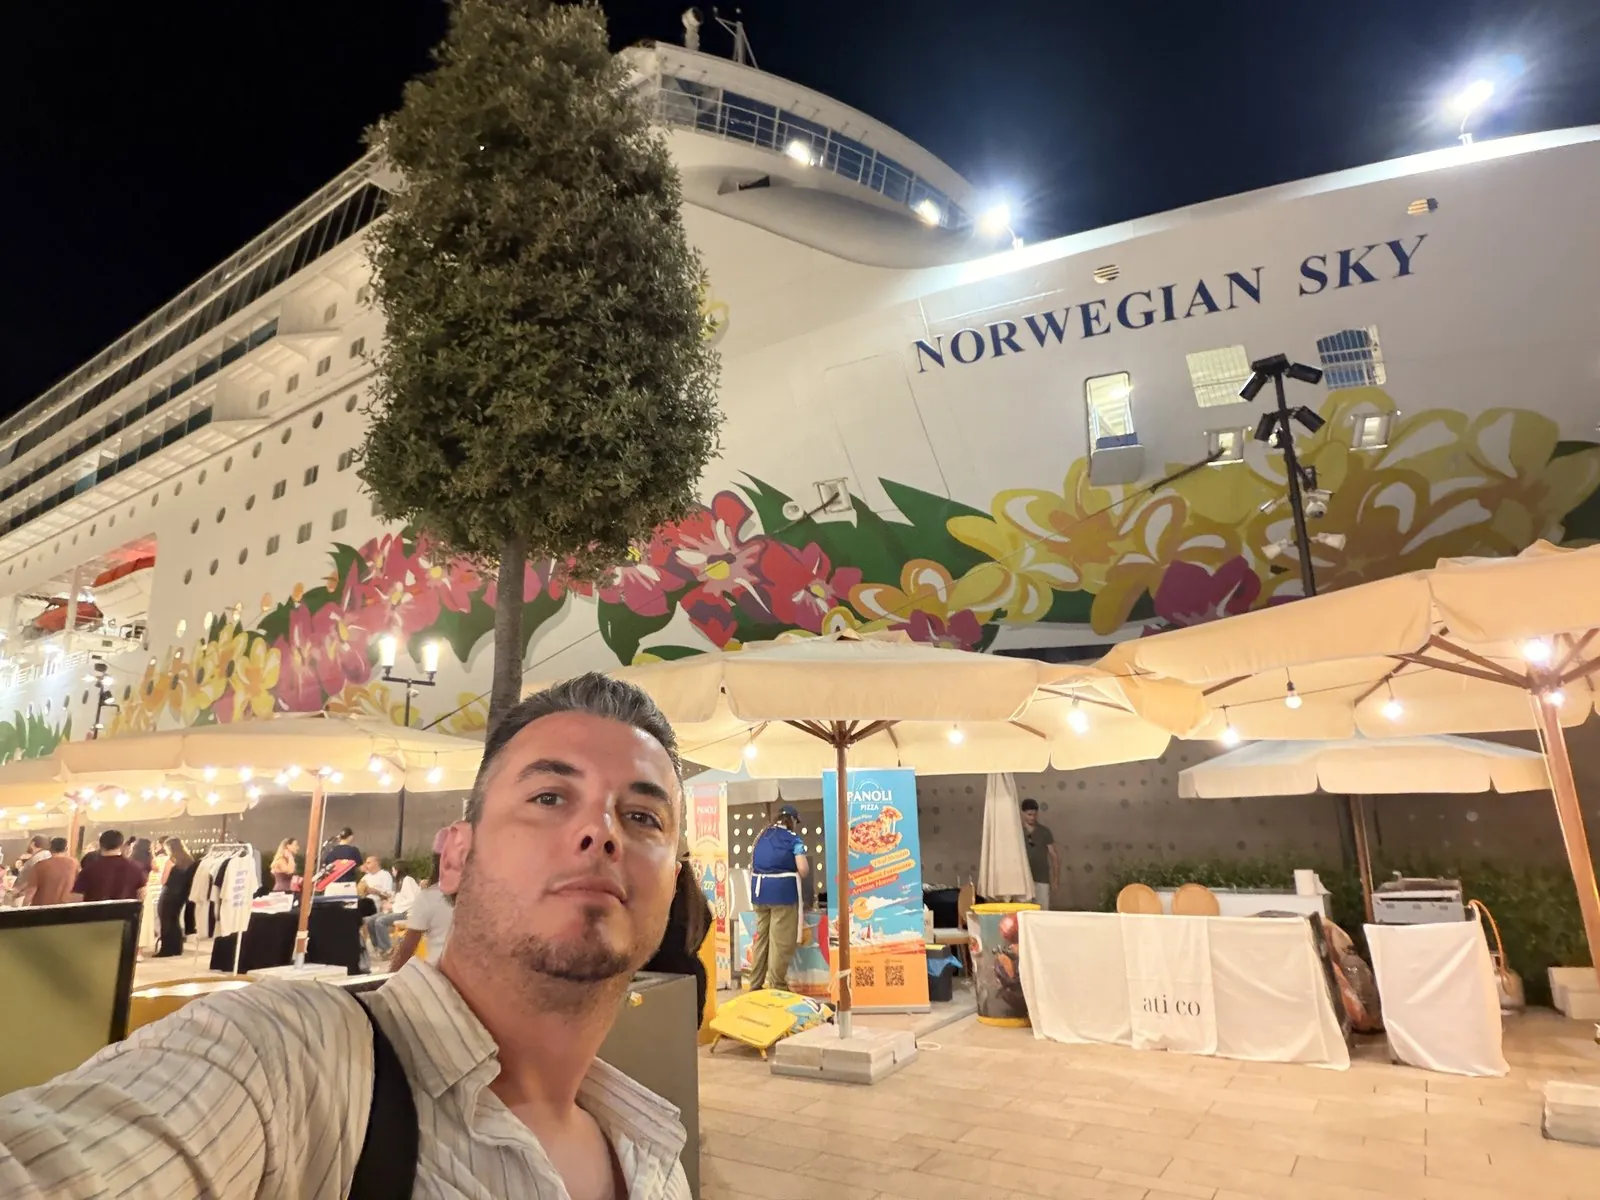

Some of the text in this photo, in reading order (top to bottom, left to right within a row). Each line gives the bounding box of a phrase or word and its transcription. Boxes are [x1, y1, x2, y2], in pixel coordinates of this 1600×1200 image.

[912, 234, 1428, 373] NORWEGIAN SKY
[847, 790, 893, 802] PANOLI
[860, 803, 879, 811] PIZZA
